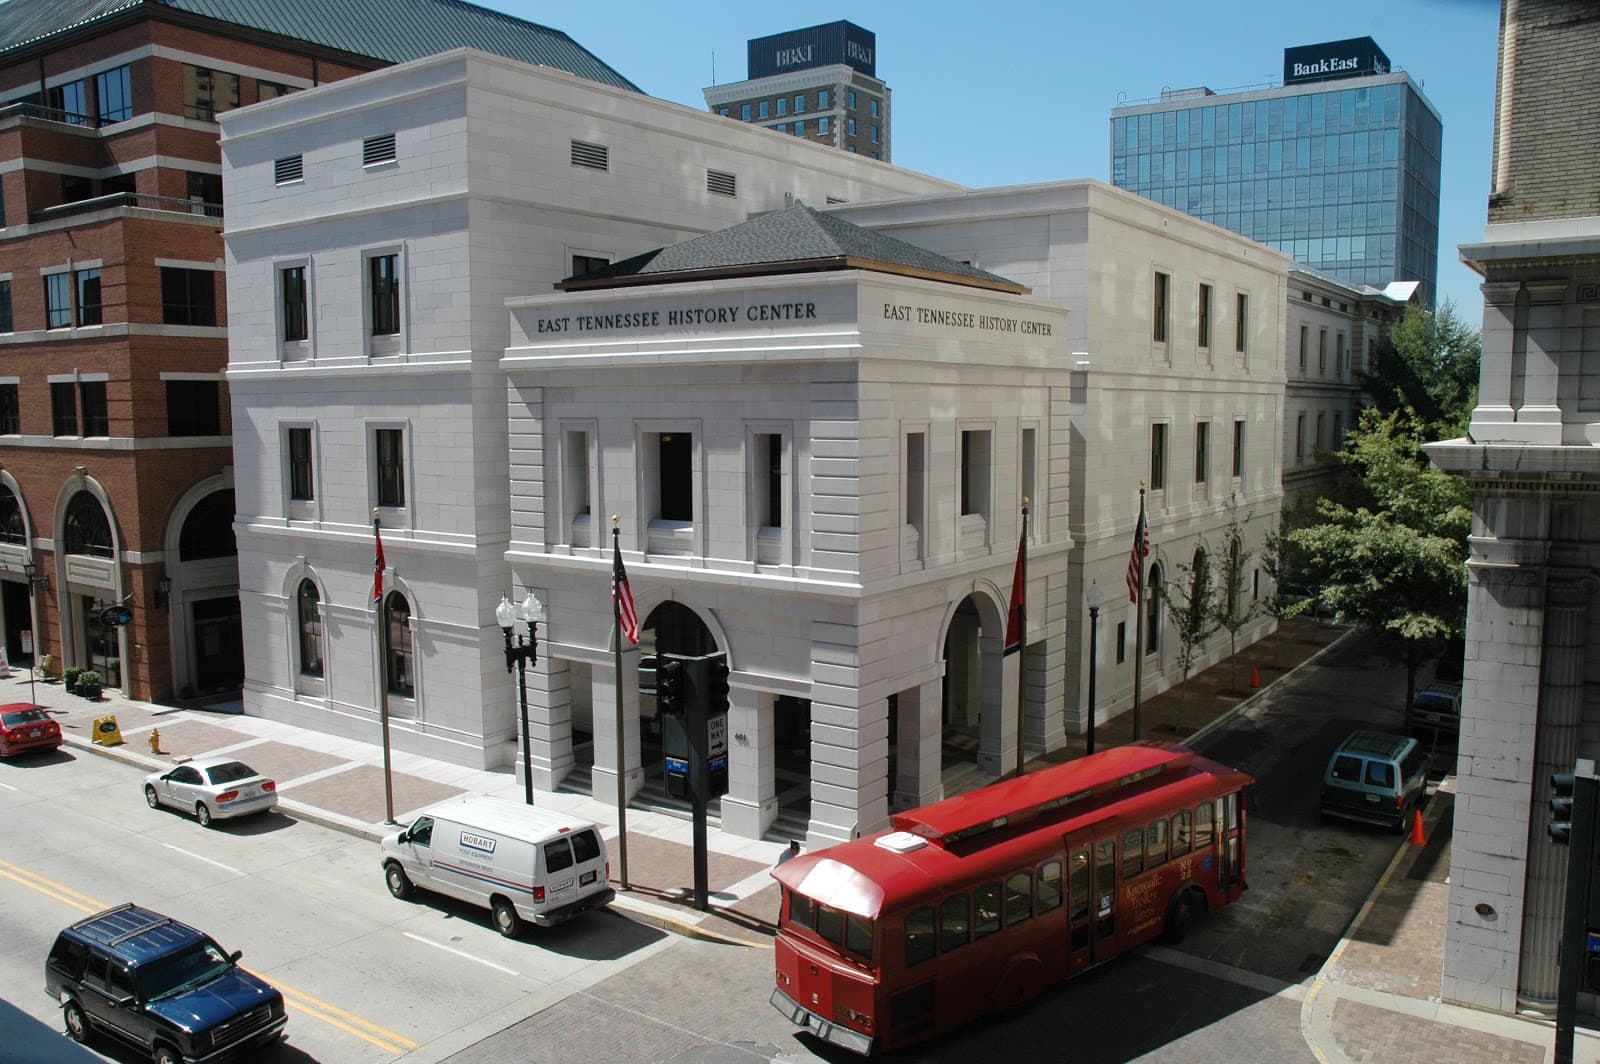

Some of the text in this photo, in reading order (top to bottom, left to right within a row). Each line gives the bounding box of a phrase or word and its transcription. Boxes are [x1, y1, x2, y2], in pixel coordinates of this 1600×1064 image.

[776, 45, 815, 67] BB&T
[1293, 56, 1359, 76] BankEast
[538, 302, 817, 334] EAST TENNESSEE HISTORY CENTER
[884, 303, 1052, 337] EAST TENNESSEE HISTORY CENTER
[710, 718, 725, 730] ONE
[710, 727, 725, 739] WAY
[463, 834, 494, 849] HOBART
